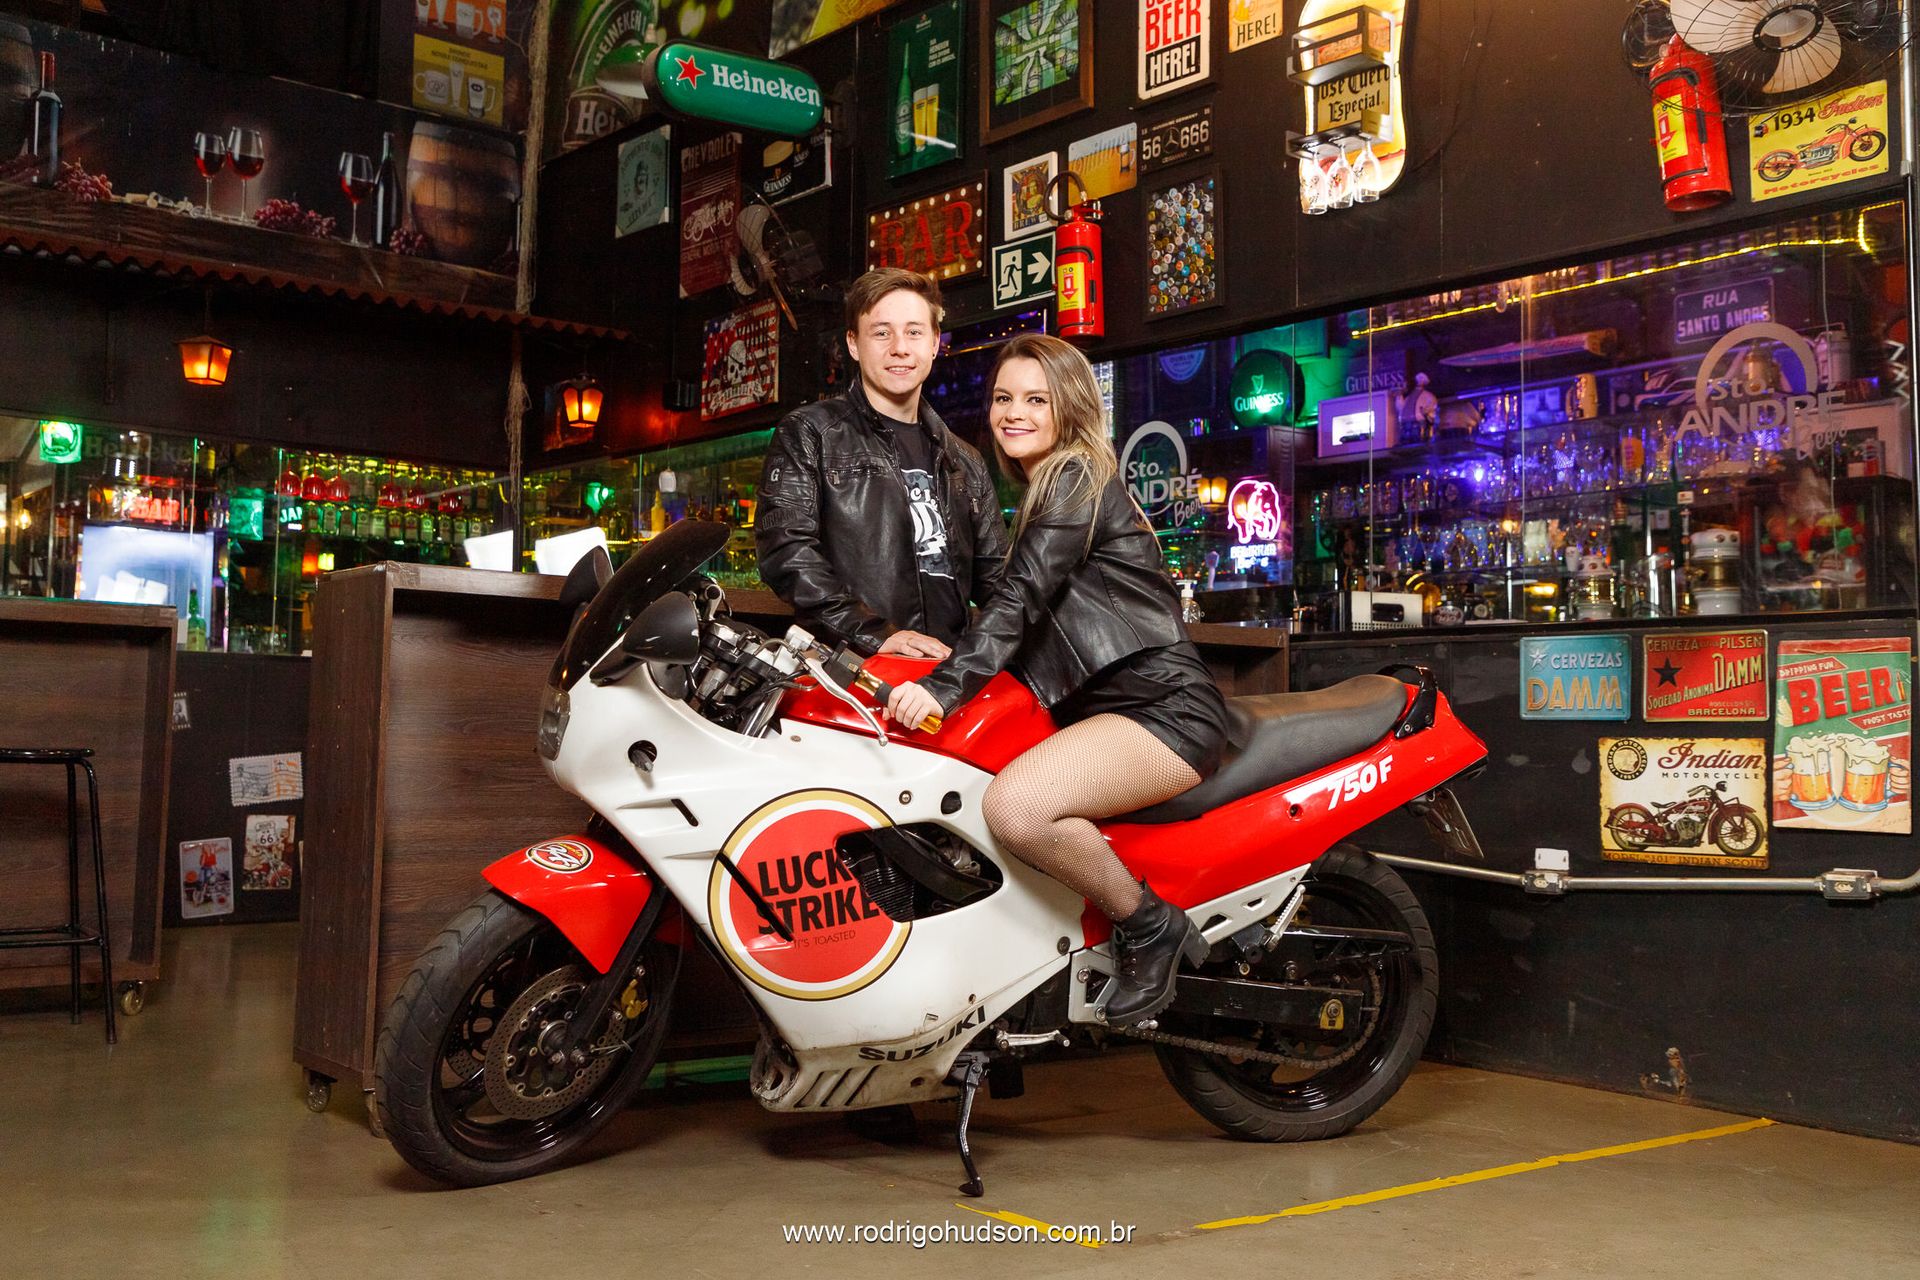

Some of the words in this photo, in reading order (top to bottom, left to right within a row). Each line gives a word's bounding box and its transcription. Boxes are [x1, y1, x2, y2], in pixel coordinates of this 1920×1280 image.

[1146, 0, 1201, 52] BEER
[1236, 12, 1277, 46] HERE!
[1149, 41, 1197, 86] HERE!
[711, 64, 821, 106] Heineken
[1329, 89, 1380, 123] Especial
[1774, 106, 1816, 131] 1934
[1817, 93, 1885, 120] Indian
[1142, 135, 1162, 161] 56
[1180, 119, 1210, 149] 666
[1763, 164, 1879, 195] Motorcycles
[877, 200, 975, 273] BAR
[1702, 289, 1738, 309] RUA
[1678, 314, 1720, 338] SANTO
[1234, 391, 1284, 412] GUINNESS
[770, 468, 780, 482] G
[1127, 460, 1164, 479] Sto.
[1127, 467, 1203, 505] NDRÉ
[1647, 638, 1699, 652] CERVEZA
[1719, 635, 1763, 649] PILSEN
[1551, 651, 1623, 669] CERVEZAS
[1711, 652, 1763, 693] DAMM
[1820, 660, 1835, 671] FUN
[1527, 674, 1623, 712] DAMM
[1787, 666, 1896, 727] BEER
[1687, 707, 1756, 717] BARCELONA
[1862, 713, 1886, 726] FROST
[1657, 742, 1764, 769] Indian
[1661, 771, 1760, 780] MOTORCYCLE
[757, 847, 853, 897] LUCK
[1602, 851, 1642, 863] MODEL
[1678, 855, 1722, 866] INDIAN
[1724, 857, 1768, 868] SCOUT
[815, 929, 856, 946] TOASTED
[858, 1004, 986, 1062] SUZUKI
